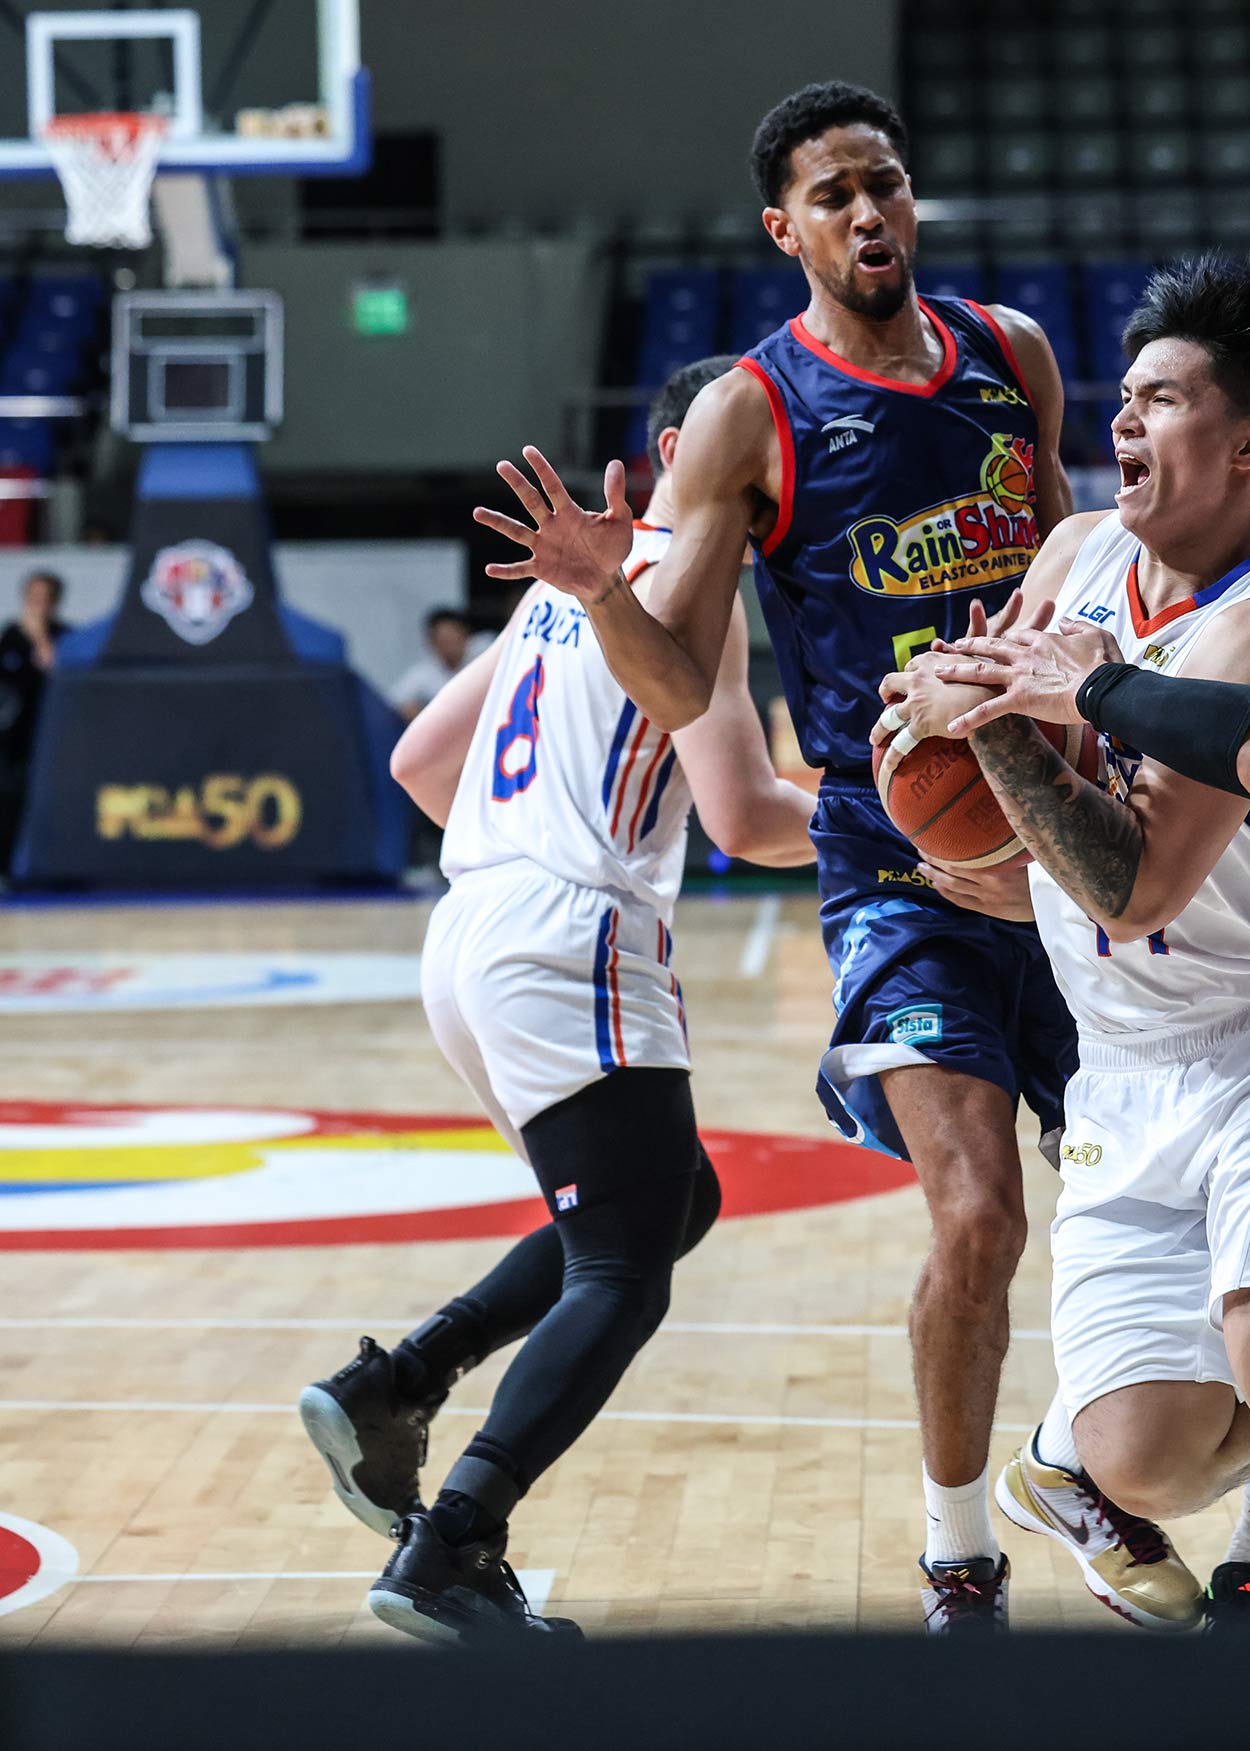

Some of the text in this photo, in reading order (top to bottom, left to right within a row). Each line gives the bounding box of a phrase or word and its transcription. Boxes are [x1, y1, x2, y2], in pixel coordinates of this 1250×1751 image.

[828, 429, 858, 453] ANTA
[852, 520, 961, 590] Rain
[937, 519, 952, 530] OR
[919, 564, 979, 590] ELASTO
[897, 1017, 933, 1034] Sista
